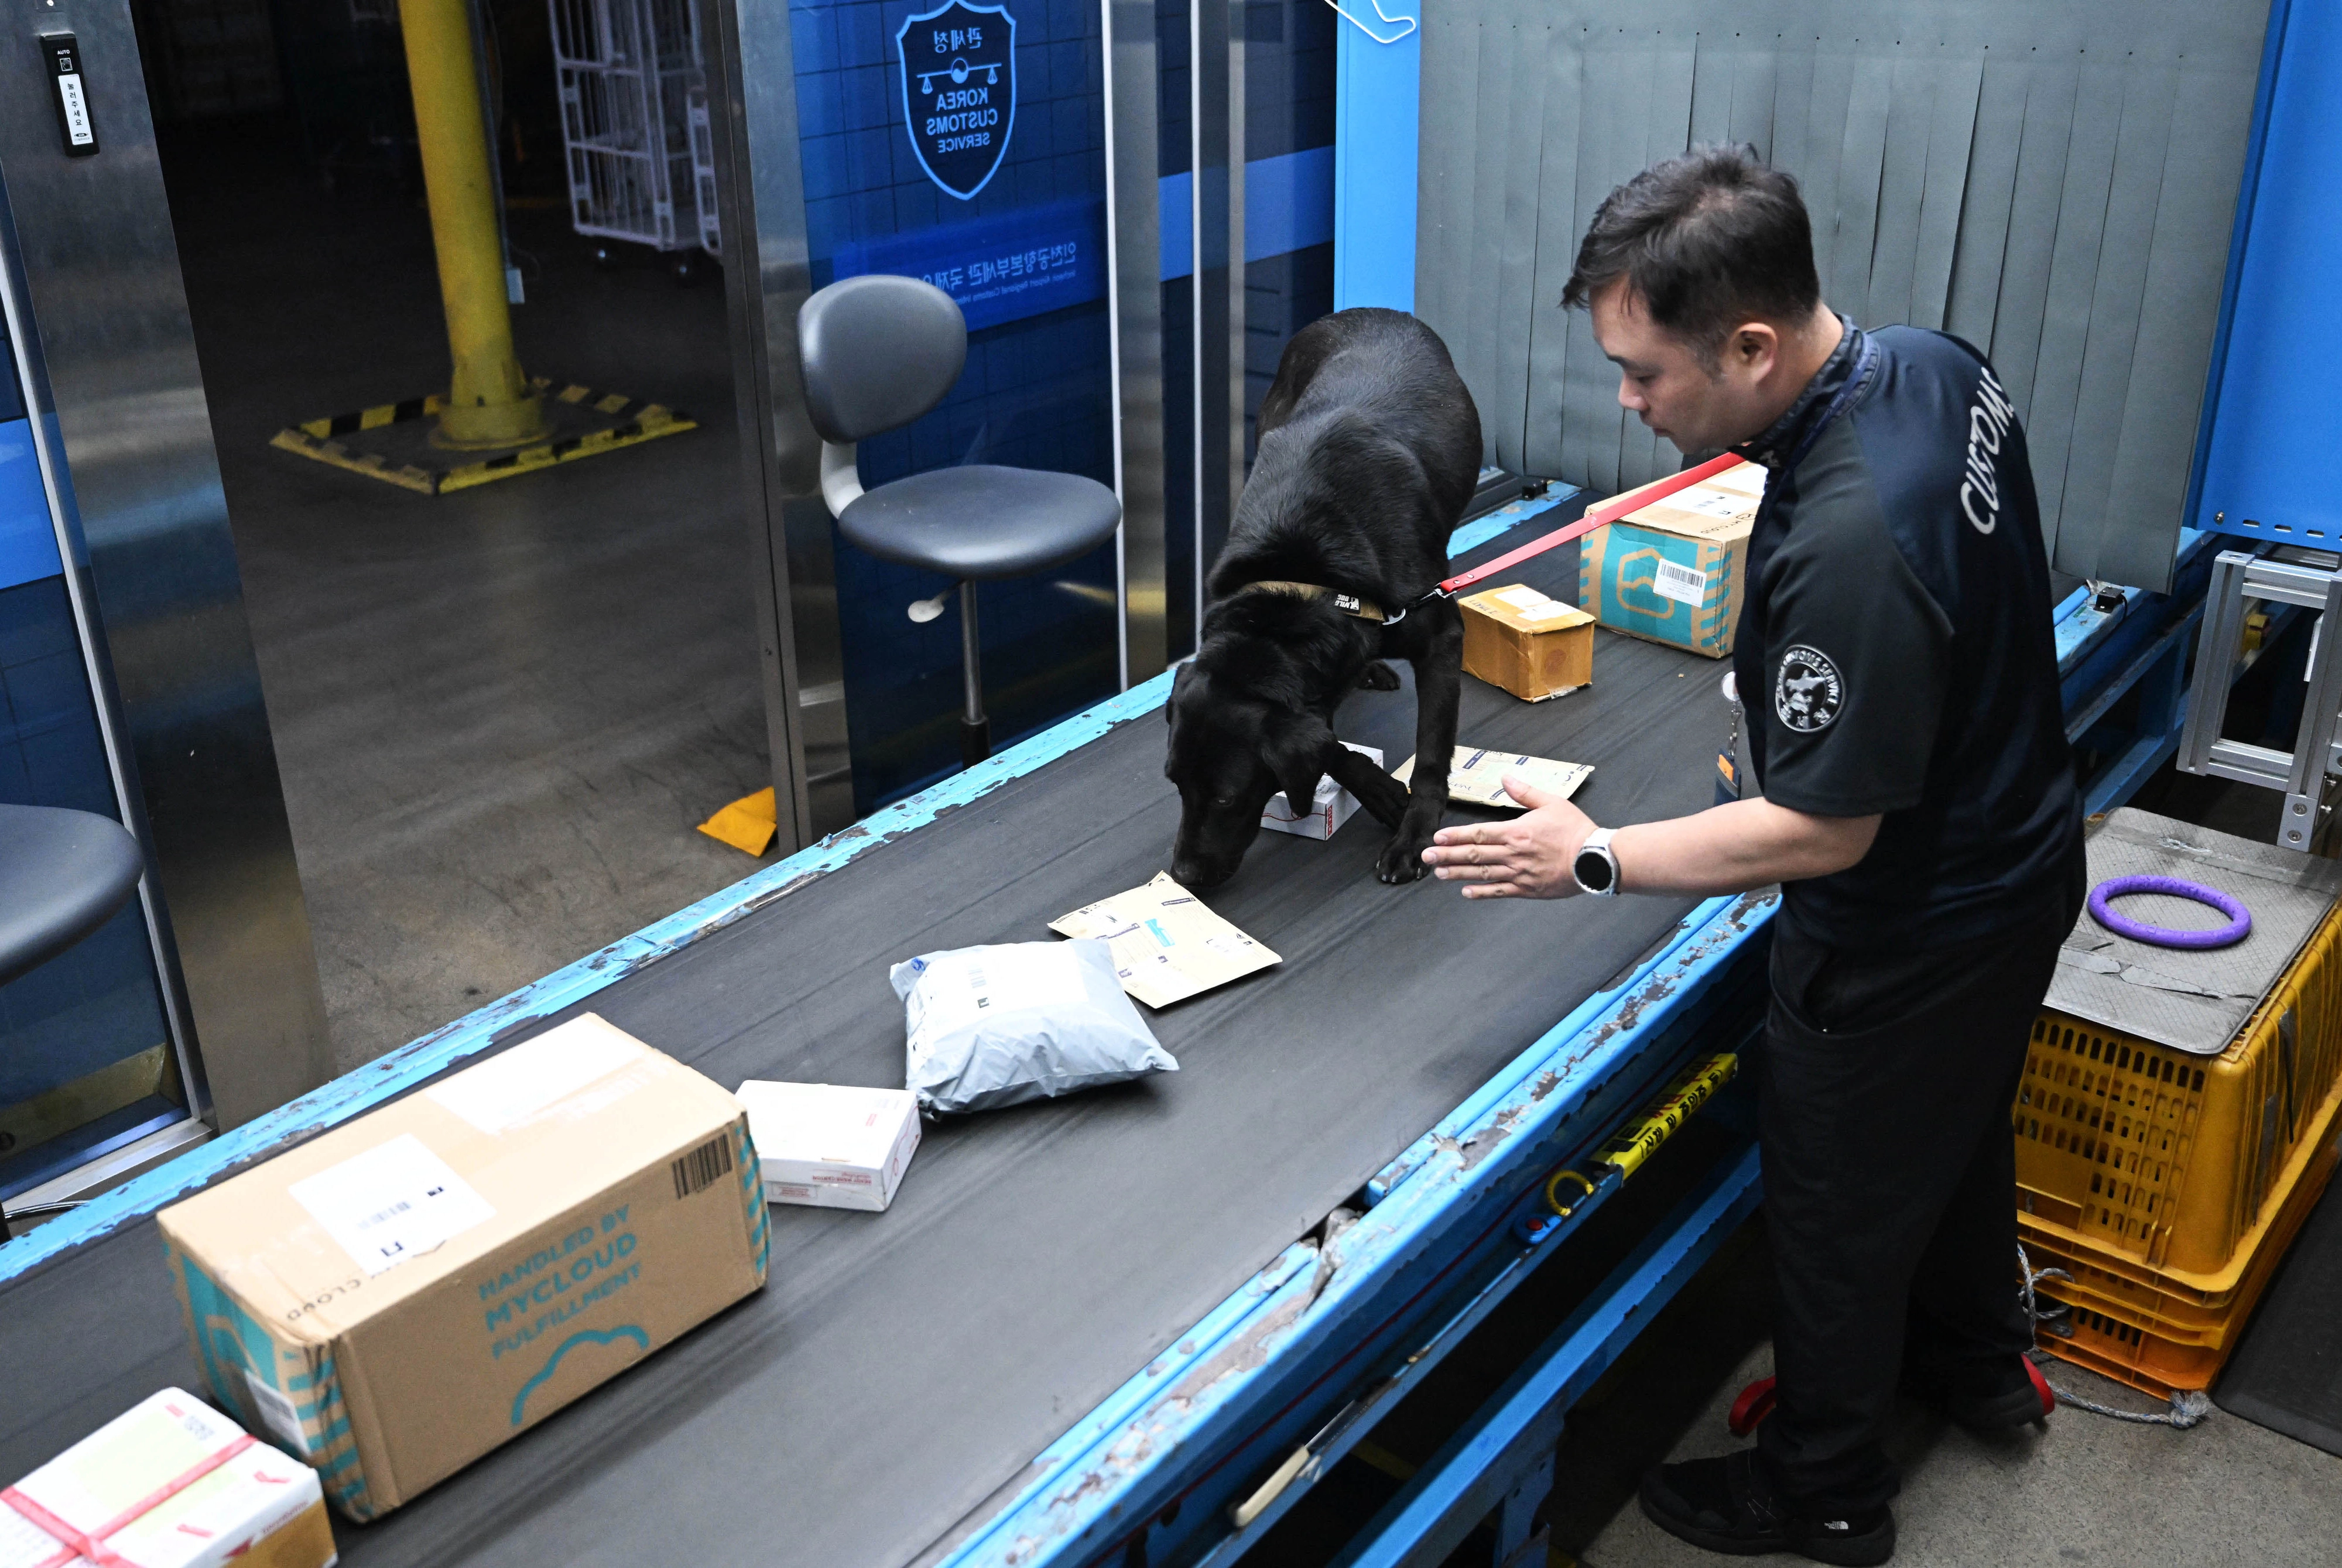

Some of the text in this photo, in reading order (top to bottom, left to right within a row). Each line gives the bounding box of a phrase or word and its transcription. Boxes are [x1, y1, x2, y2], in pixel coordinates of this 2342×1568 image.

[67, 83, 83, 126] 눌러주세요
[1700, 523, 1729, 535] CLOUD
[1334, 600, 1350, 608] WILD
[1337, 594, 1350, 602] DOG
[479, 1203, 629, 1301] HANDLED BY
[287, 1278, 361, 1321] CLOUD
[485, 1233, 636, 1333] MYCLOUD
[492, 1262, 641, 1360] FULFILLMENT
